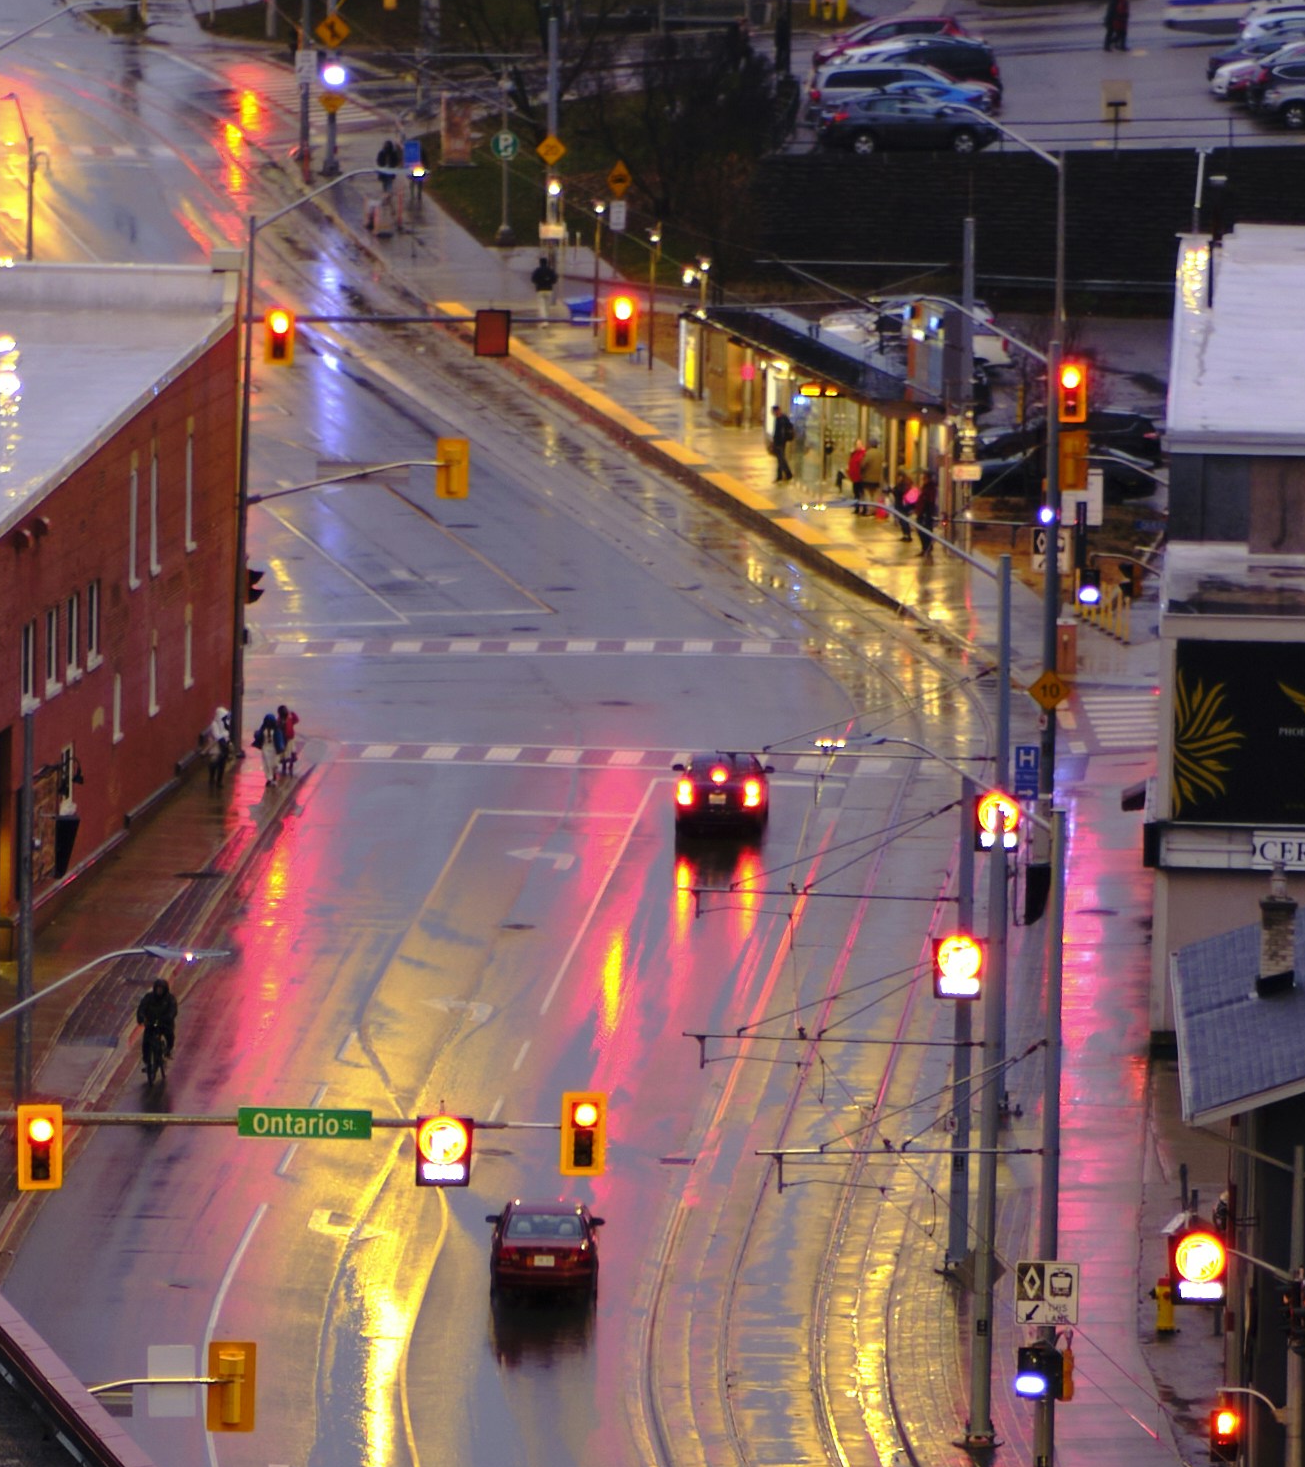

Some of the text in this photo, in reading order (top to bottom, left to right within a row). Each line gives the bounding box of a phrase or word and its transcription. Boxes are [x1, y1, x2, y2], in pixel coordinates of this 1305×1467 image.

[1041, 683, 1060, 699] 10
[1019, 749, 1035, 768] H
[252, 1113, 357, 1136] Ontario St.
